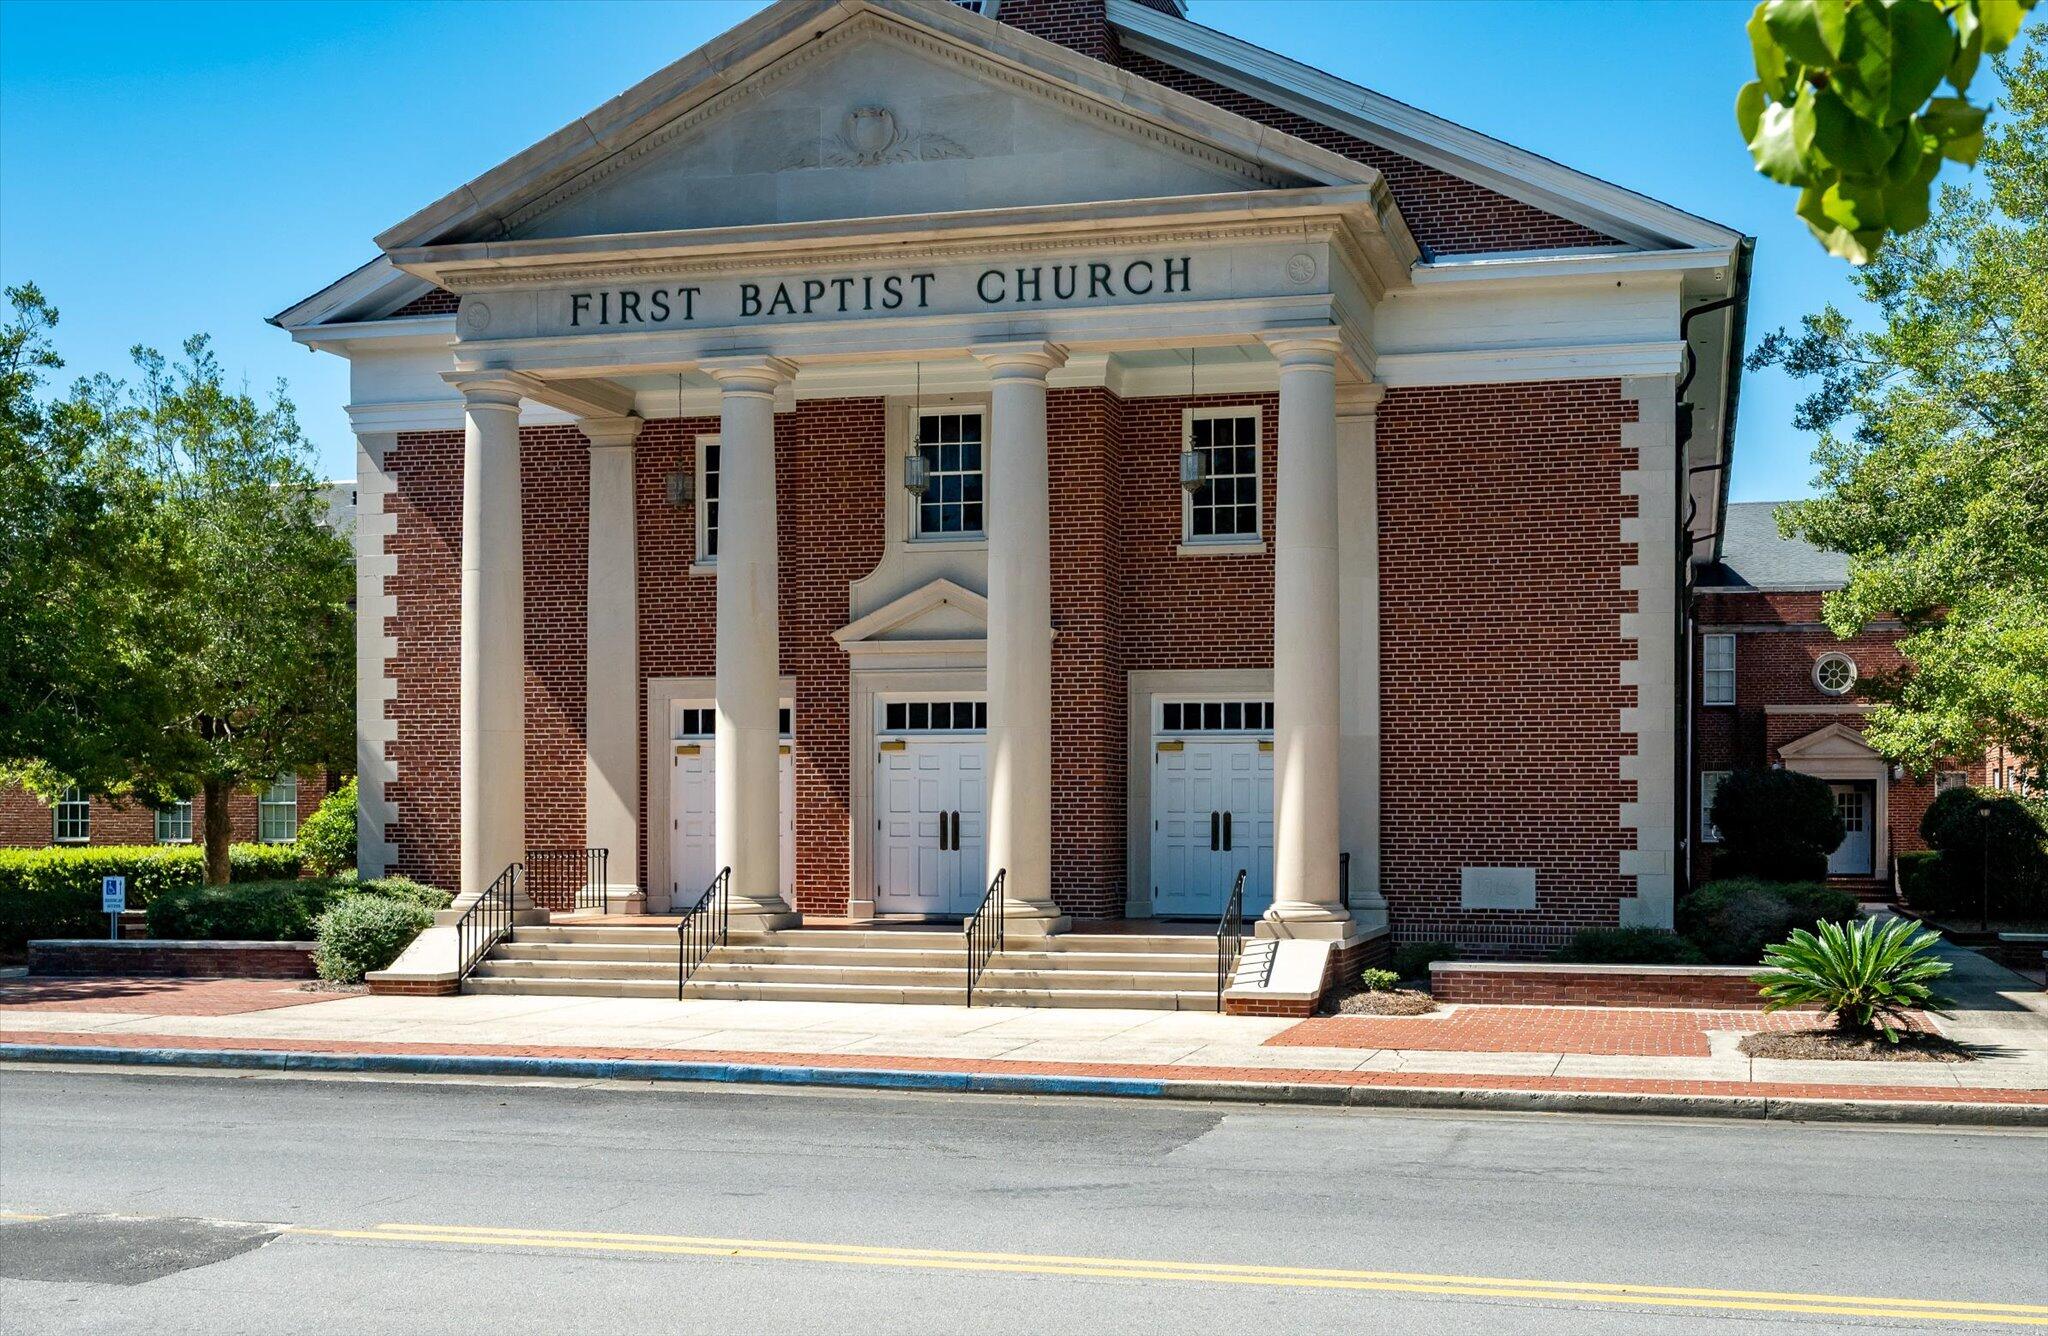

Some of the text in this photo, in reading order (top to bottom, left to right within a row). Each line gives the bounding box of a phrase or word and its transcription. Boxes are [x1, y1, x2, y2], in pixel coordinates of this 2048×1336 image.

[570, 257, 1192, 326] FIRST BAPTIST CHURCH
